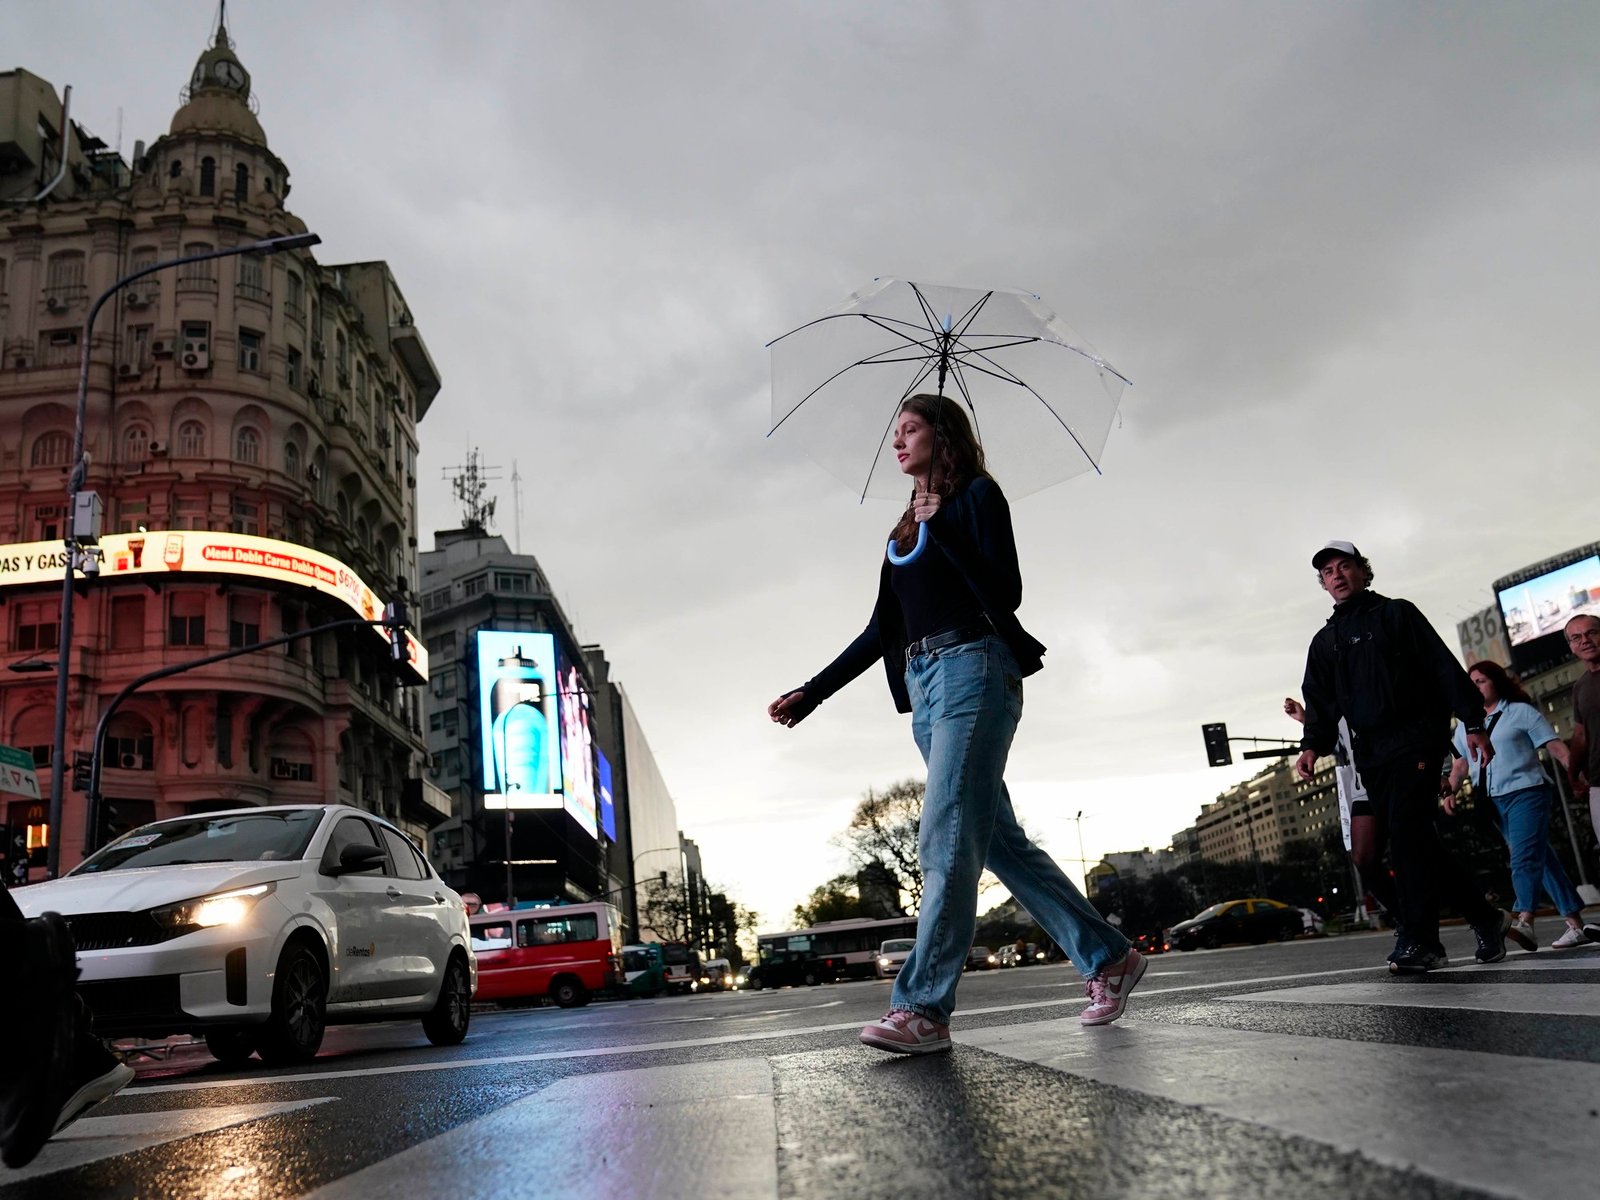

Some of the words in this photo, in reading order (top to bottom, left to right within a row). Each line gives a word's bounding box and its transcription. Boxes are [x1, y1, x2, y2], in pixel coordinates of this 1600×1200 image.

[0, 556, 20, 573] AS
[25, 555, 34, 571] Y
[38, 549, 105, 570] GASA
[205, 547, 233, 561] Menú
[235, 549, 264, 564] Doble
[265, 553, 291, 569] Carne
[292, 559, 314, 575] Doble
[1461, 607, 1497, 649] 436
